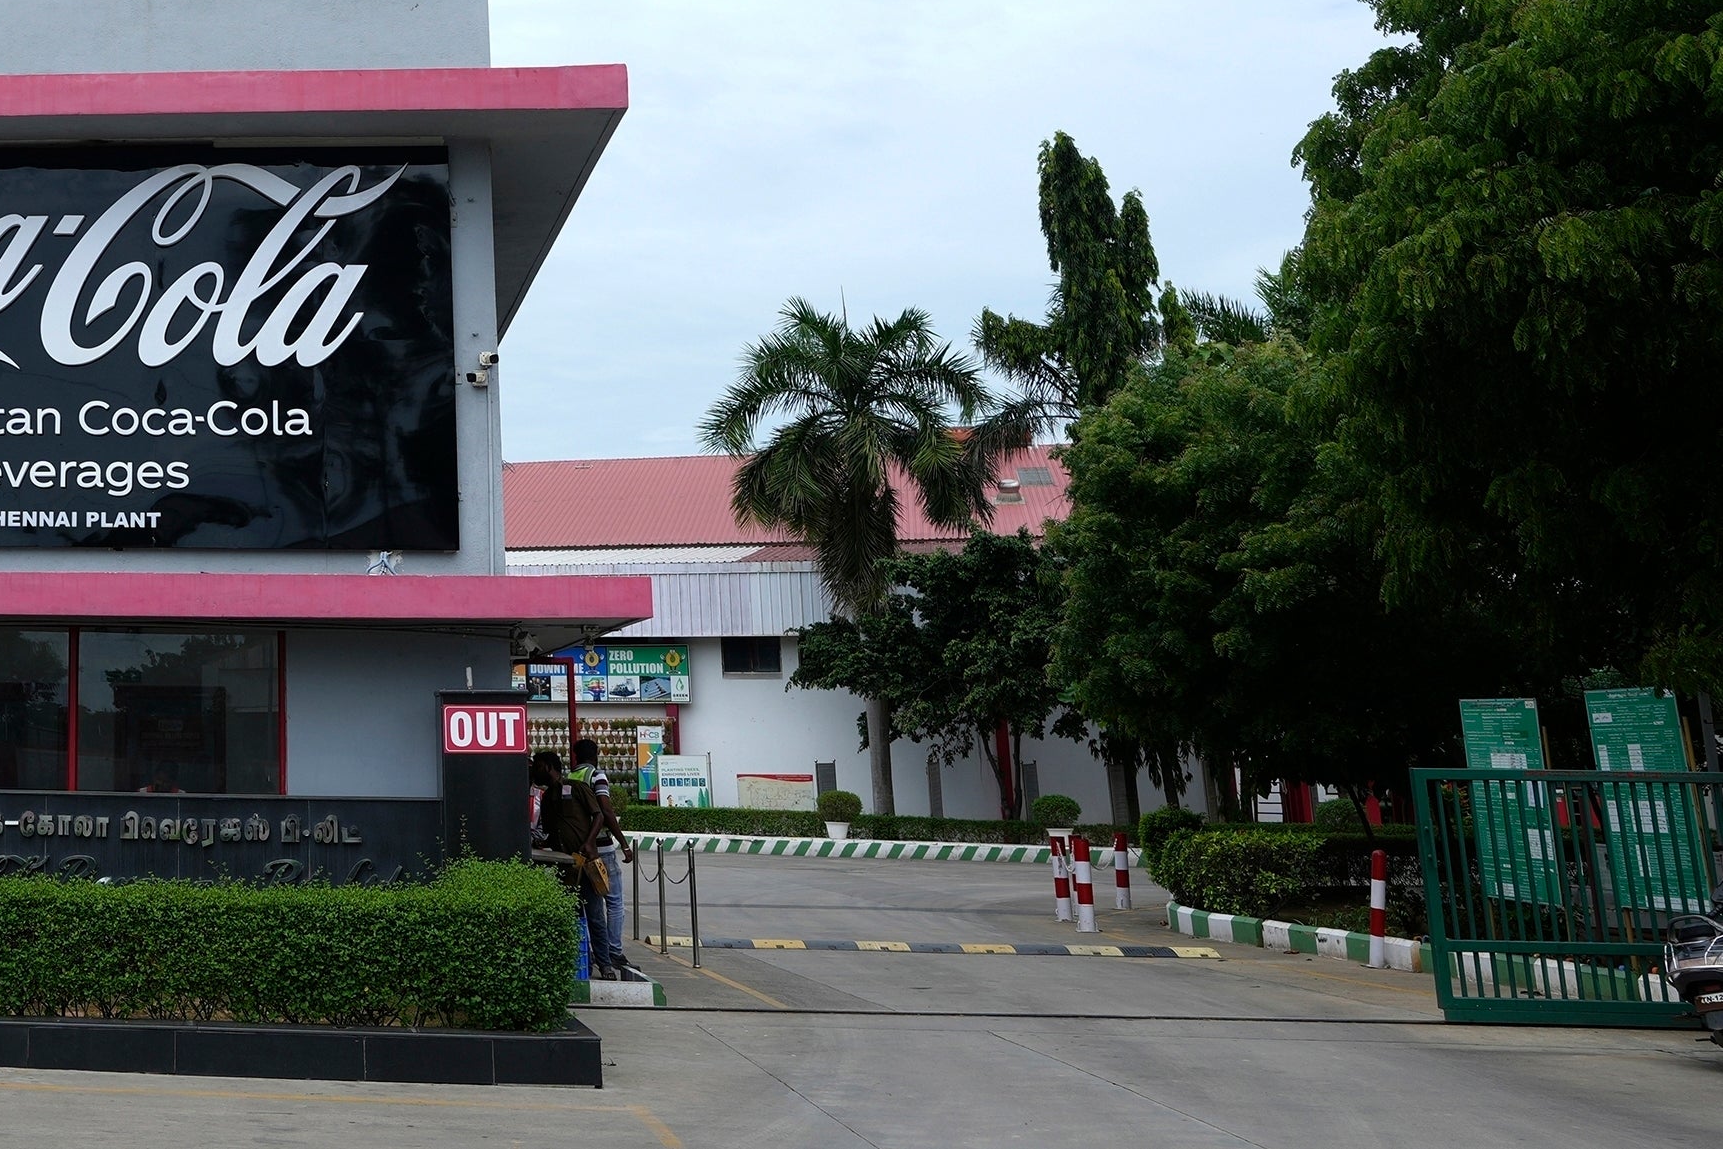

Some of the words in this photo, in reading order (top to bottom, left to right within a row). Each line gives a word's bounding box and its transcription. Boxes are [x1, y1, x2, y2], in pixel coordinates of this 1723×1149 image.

[78, 399, 313, 436] Coca-Cola
[86, 511, 162, 528] PLANT
[608, 650, 634, 661] ZERO
[609, 663, 664, 674] POLLUTION
[450, 711, 520, 747] OUT
